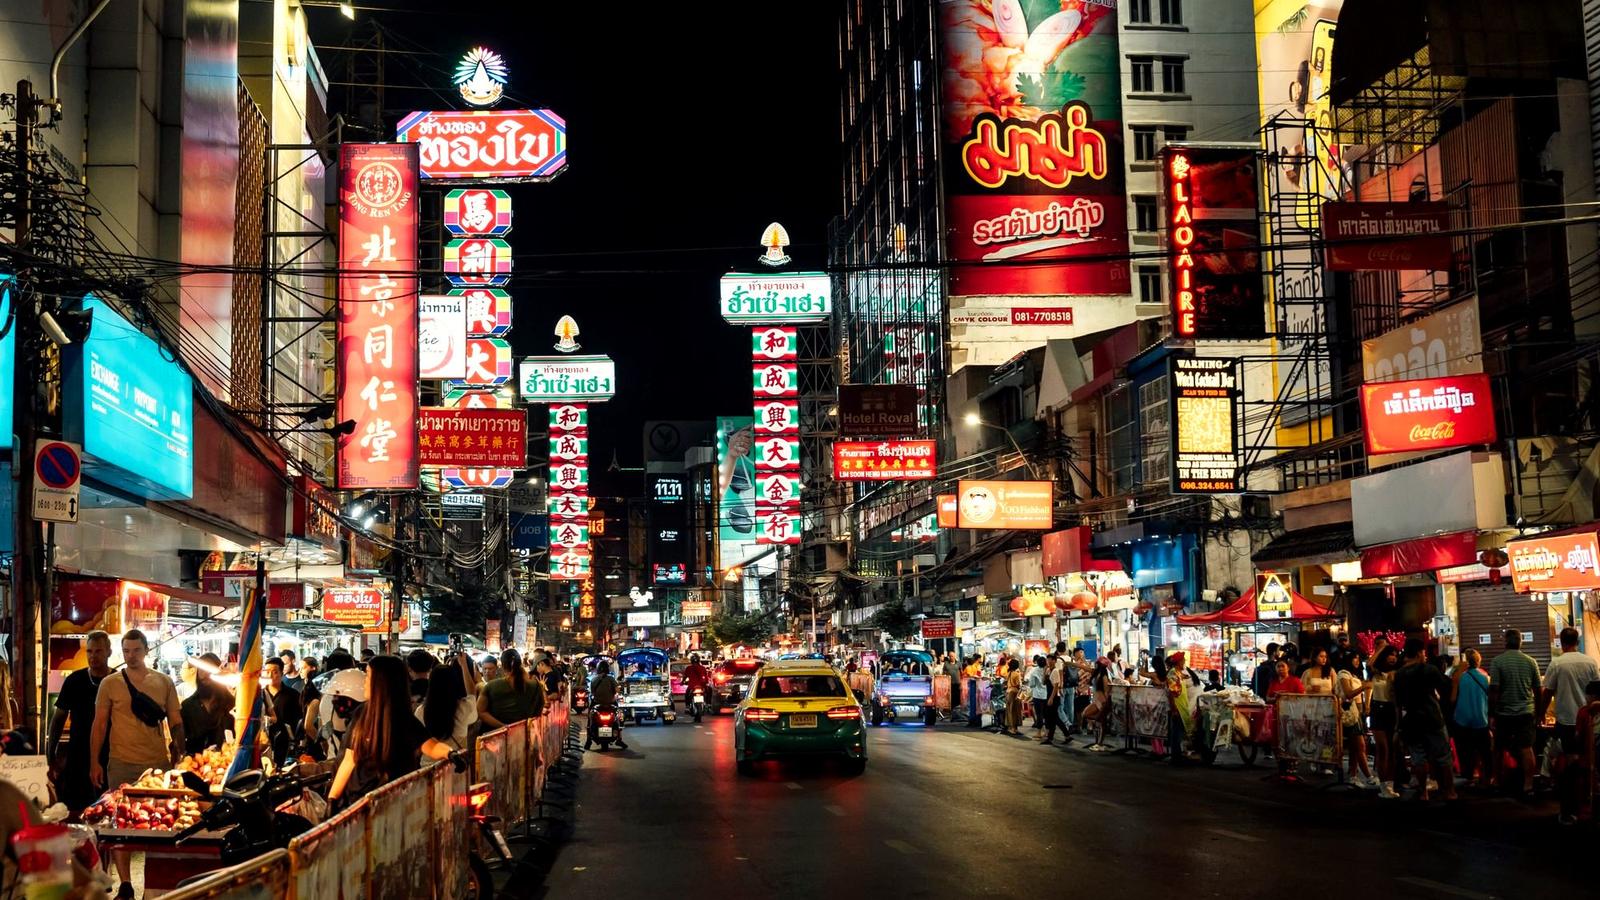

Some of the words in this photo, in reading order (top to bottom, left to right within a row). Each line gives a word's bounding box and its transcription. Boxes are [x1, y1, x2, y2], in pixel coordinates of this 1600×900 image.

[419, 119, 548, 168] ทองใบ
[962, 105, 1107, 188] มาม่า
[973, 198, 1104, 245] รสต้มยำกุ้ง
[728, 286, 826, 313] ฮั่วเซ่งเฮง
[1015, 312, 1071, 322] 081-7708518
[360, 226, 398, 463] 北京同仁堂
[1177, 360, 1223, 369] WARNING
[526, 369, 610, 393] ฮั่วเซ่งเฮง
[843, 412, 875, 424] Hotel
[879, 412, 913, 425] Royal
[763, 332, 790, 539] 和成興大金行
[1179, 469, 1190, 478] IN
[1191, 469, 1210, 478] THE
[1210, 469, 1235, 478] BREW
[558, 404, 580, 576] 和成興大金行
[655, 483, 682, 495] 11.11
[520, 526, 541, 535] UOB
